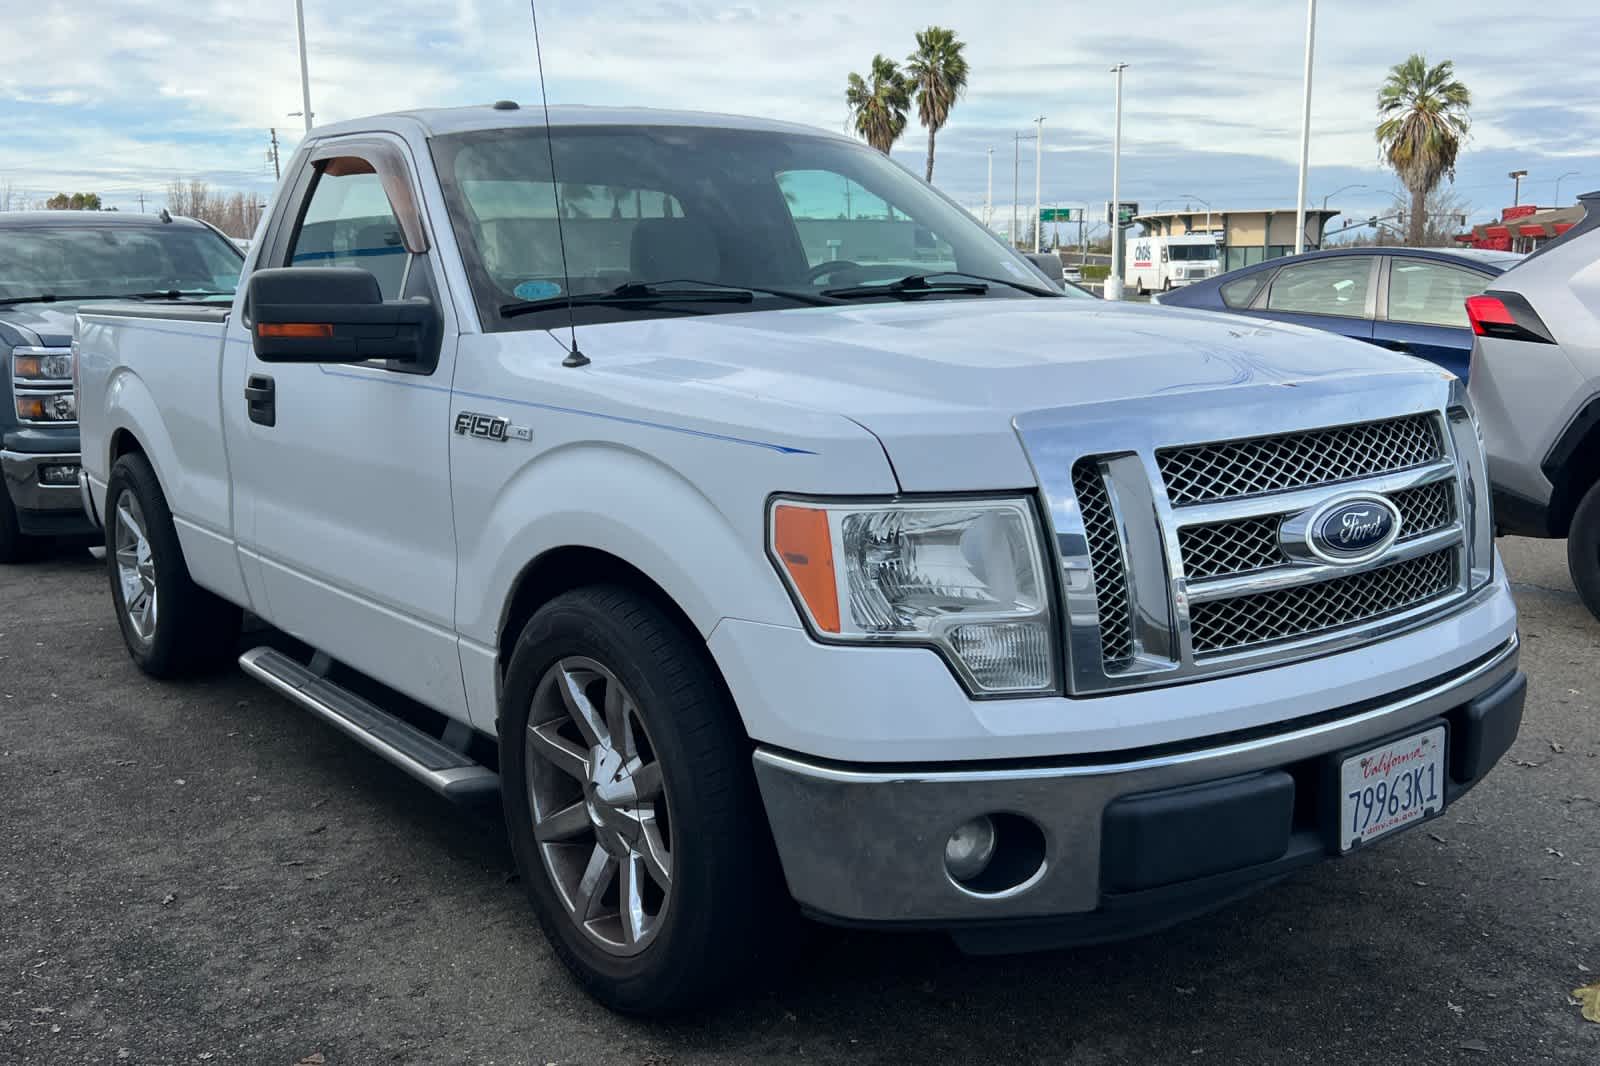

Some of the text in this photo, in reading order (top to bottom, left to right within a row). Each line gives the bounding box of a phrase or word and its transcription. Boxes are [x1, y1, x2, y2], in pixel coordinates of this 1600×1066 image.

[455, 414, 505, 438] F-150
[1340, 511, 1381, 543] Ford
[1362, 747, 1424, 778] California
[1349, 762, 1438, 832] 79963K1
